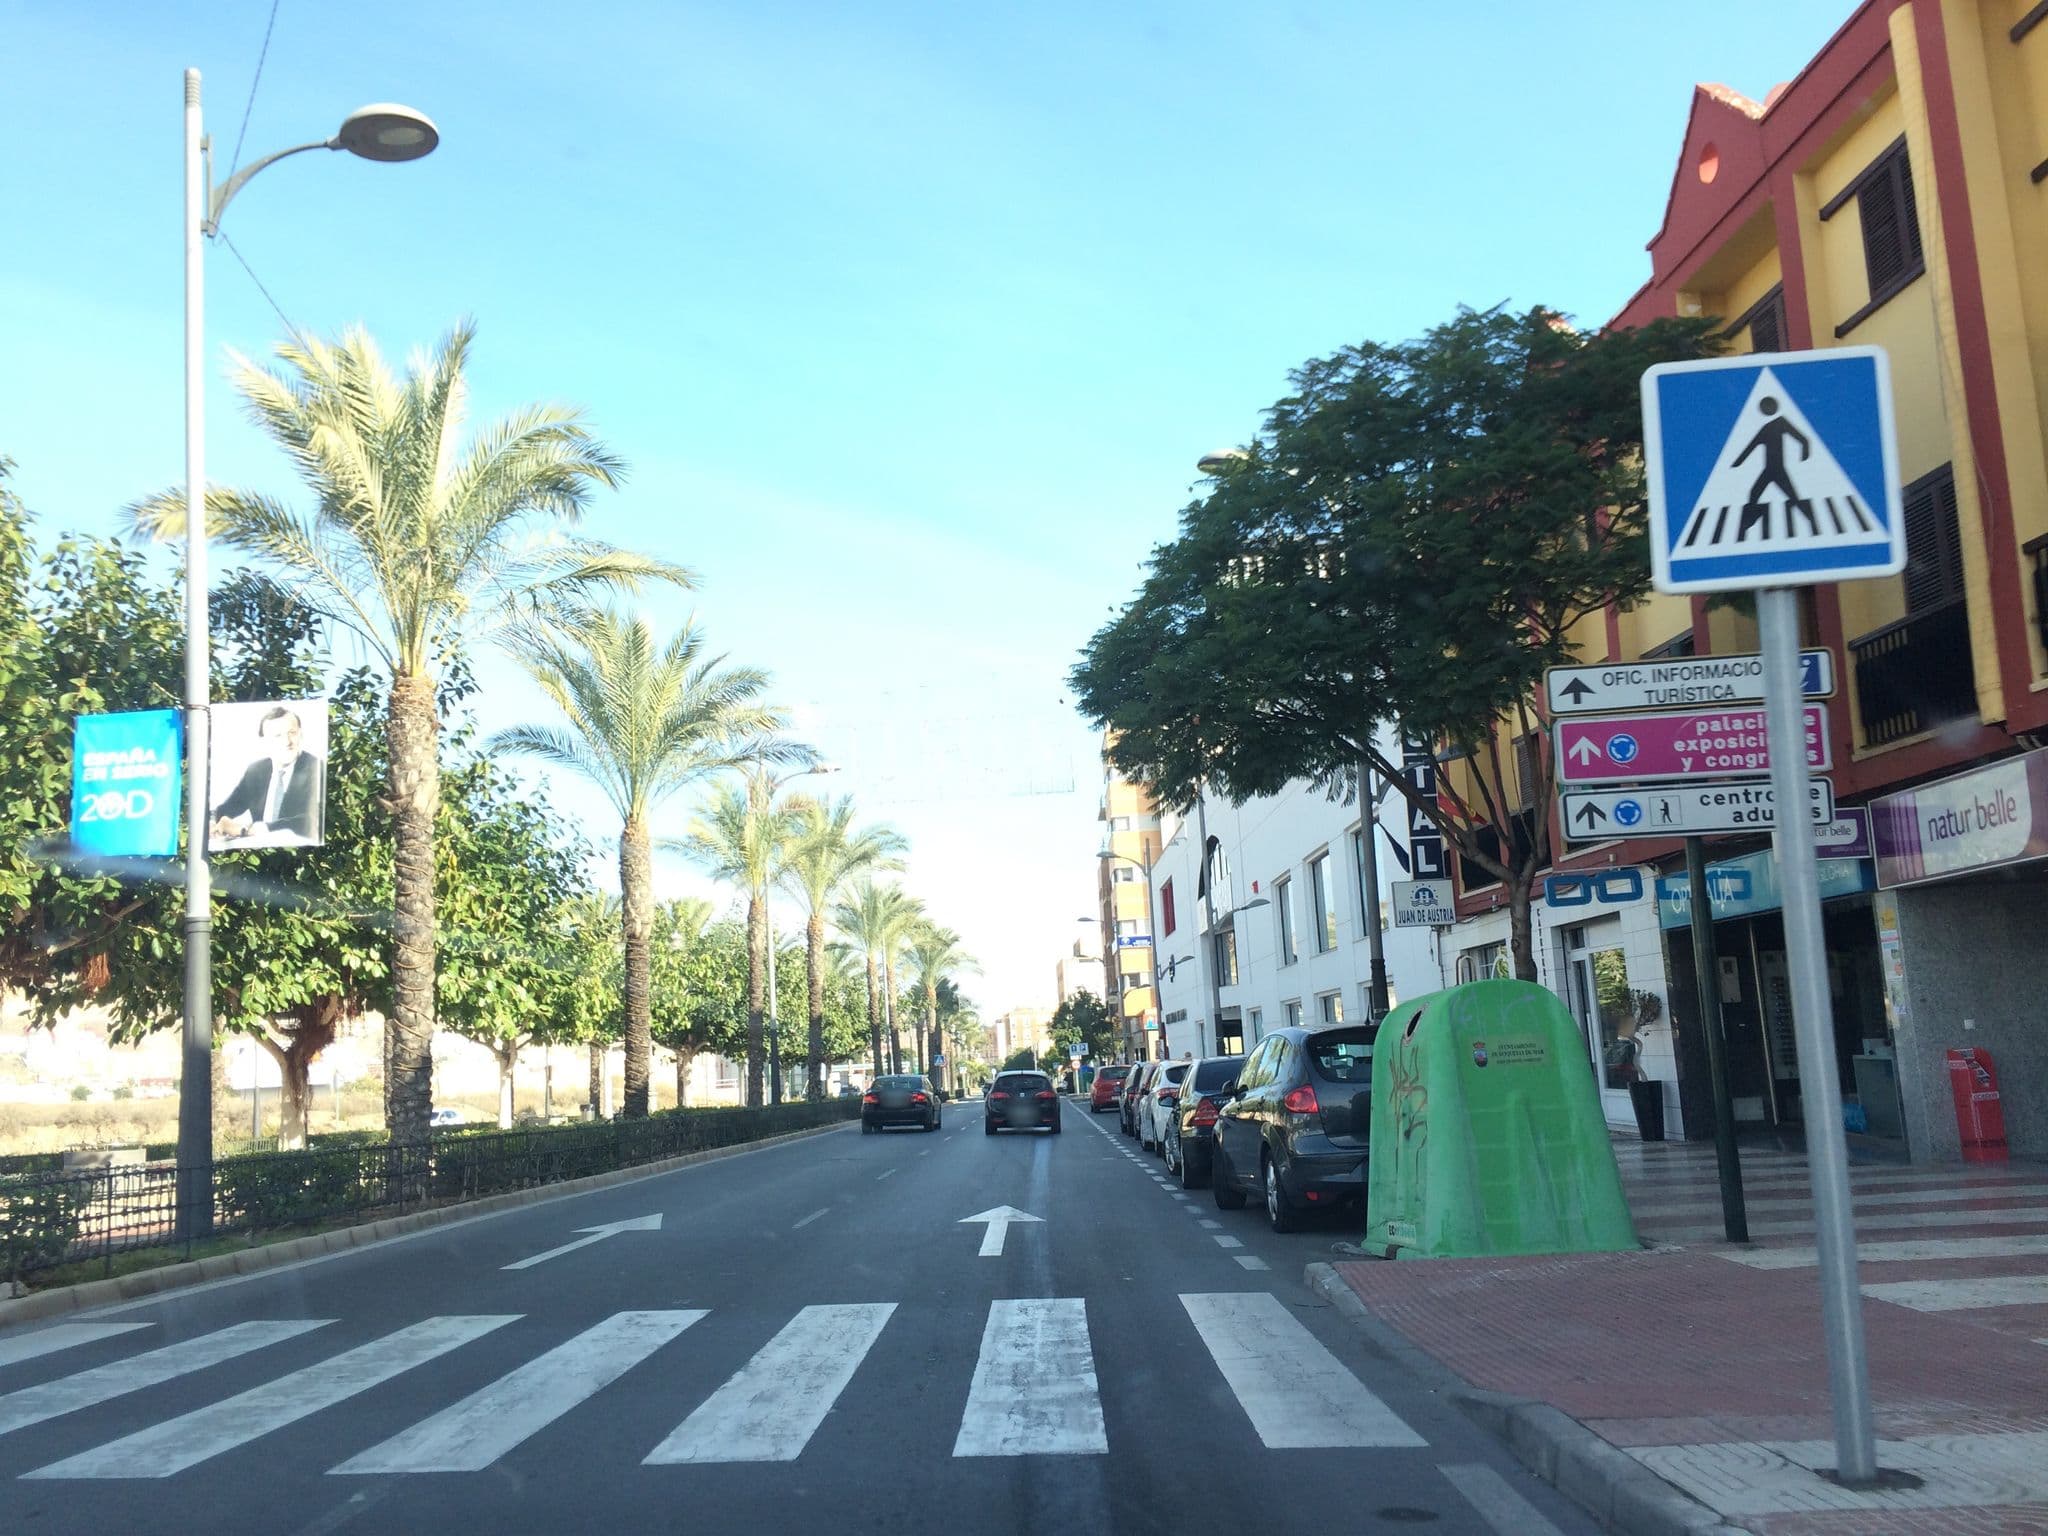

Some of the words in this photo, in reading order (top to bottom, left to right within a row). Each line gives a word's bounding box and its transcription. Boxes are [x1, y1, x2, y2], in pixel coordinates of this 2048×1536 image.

[1602, 669, 1648, 687] OFIC.
[1652, 660, 1764, 683] INFORMACIÓ
[1644, 683, 1736, 704] TURÍSTICA
[1696, 714, 1768, 736] palaci
[1681, 757, 1693, 772] y
[1928, 807, 1971, 842] natur
[1975, 787, 2018, 831] belle
[1398, 909, 1416, 924] JUAN
[1417, 909, 1427, 922] DE
[1428, 907, 1455, 922] AUSTRIA
